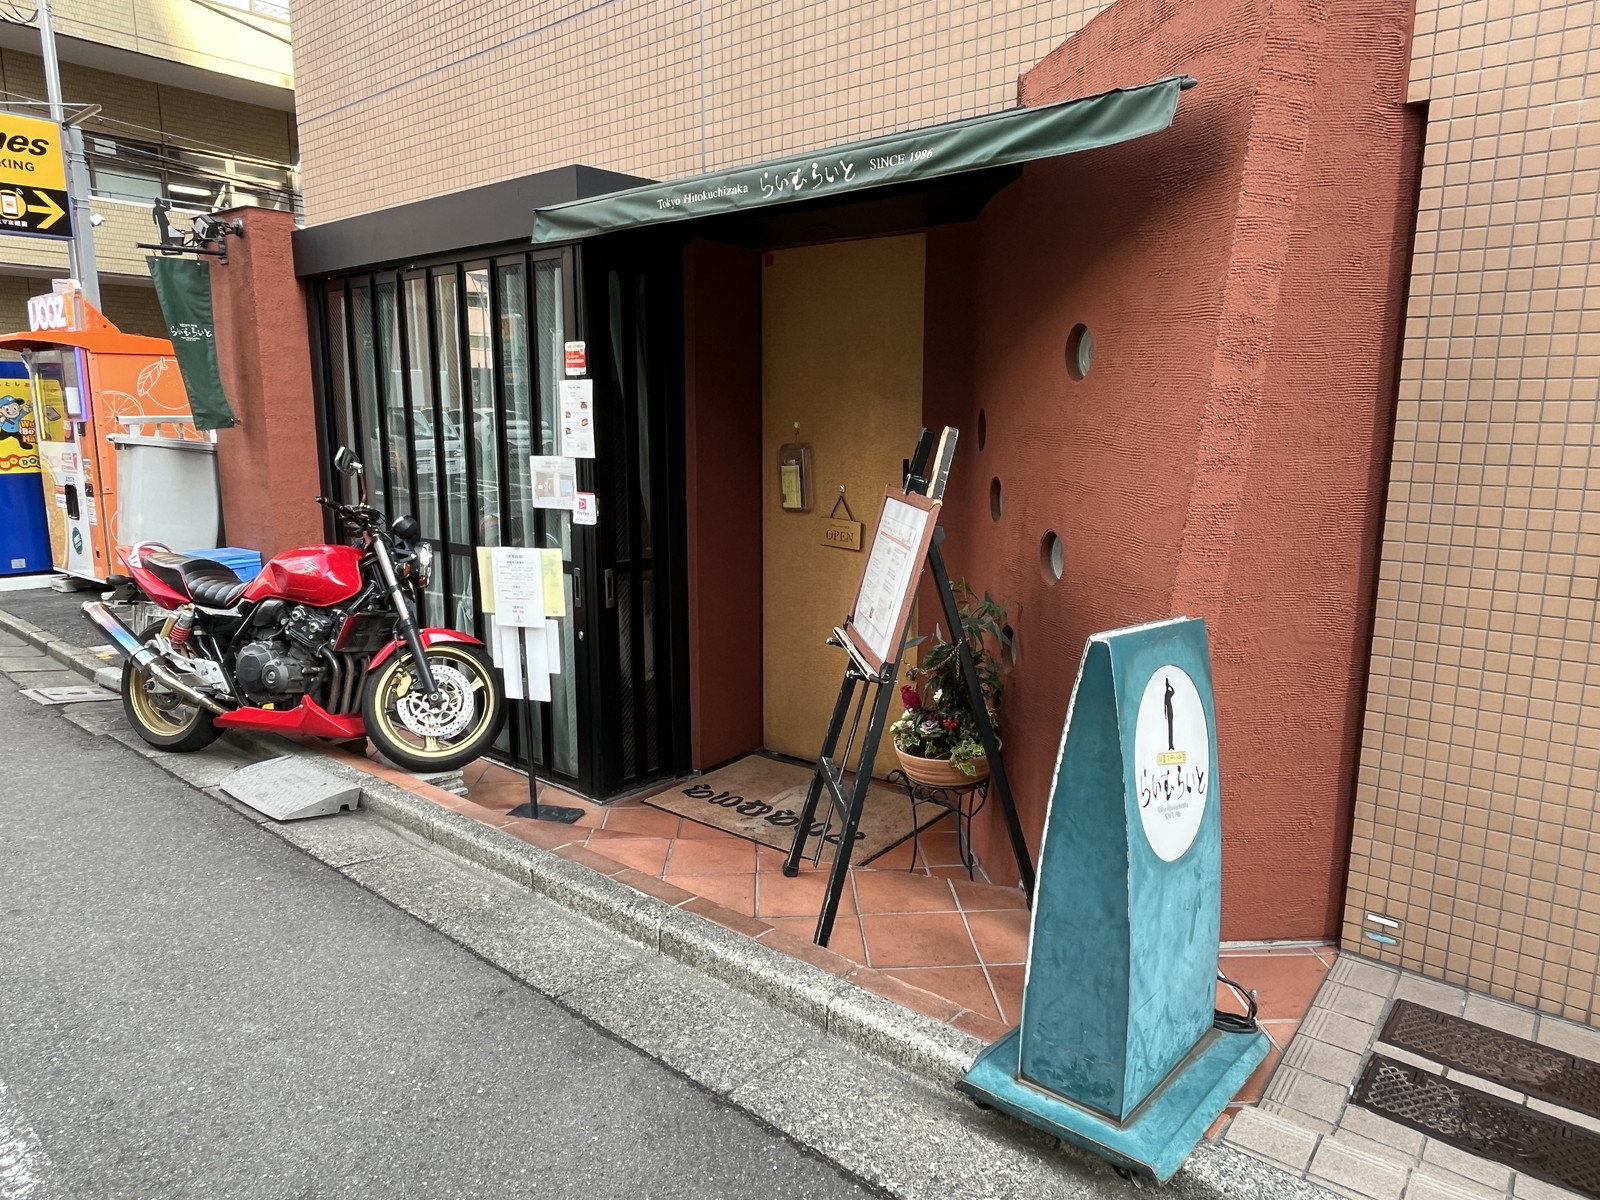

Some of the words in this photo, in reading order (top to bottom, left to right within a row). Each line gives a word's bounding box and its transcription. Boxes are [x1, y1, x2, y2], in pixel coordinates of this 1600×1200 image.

[0, 131, 50, 156] es
[657, 198, 681, 210] Tokyo
[683, 183, 749, 204] Hitokuchizaka
[760, 159, 856, 199] らいむらいと
[869, 152, 905, 171] SINCE
[909, 147, 934, 163] 1986
[826, 529, 854, 543] OPEN
[1140, 765, 1206, 808] らいむらいと
